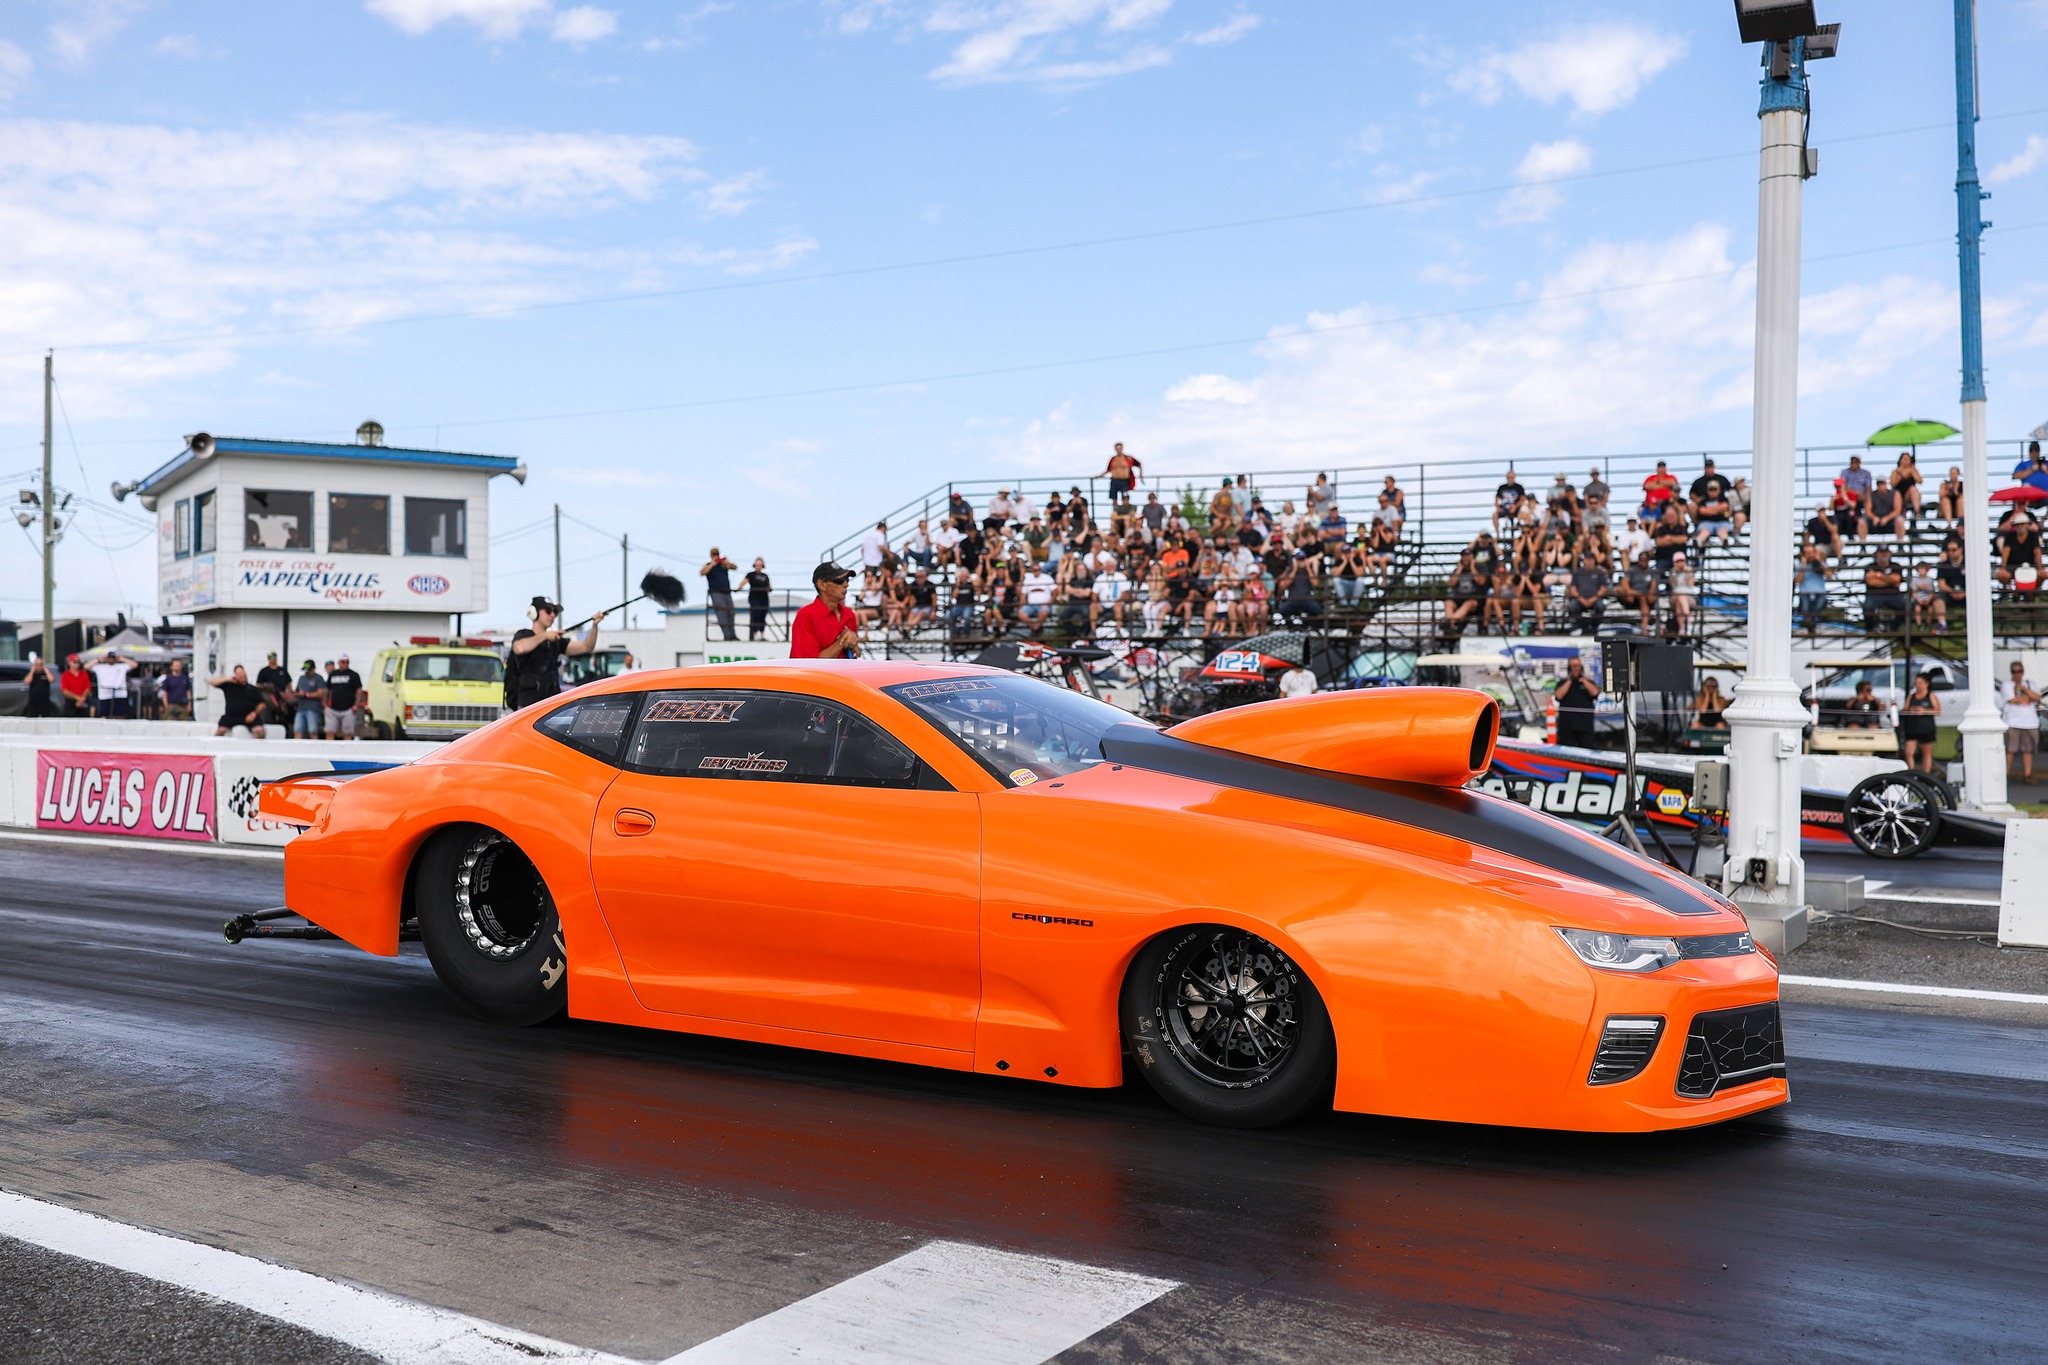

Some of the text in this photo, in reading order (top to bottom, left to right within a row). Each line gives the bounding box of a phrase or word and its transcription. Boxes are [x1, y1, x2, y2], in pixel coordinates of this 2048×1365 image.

[269, 560, 282, 569] DE
[291, 560, 335, 573] COURSE
[239, 571, 379, 593] NAPIERVILLE
[411, 576, 447, 592] NHRA
[324, 589, 383, 602] DRAGWAY
[1216, 652, 1259, 671] 124
[643, 700, 746, 722] 1826X
[699, 755, 787, 772] KEV POITRAS
[1016, 774, 1035, 783] KING
[39, 766, 206, 832] LUCAS OIL
[1662, 796, 1682, 806] NAPA
[480, 851, 497, 893] WELD
[1012, 912, 1093, 927] CAMARO
[1155, 932, 1197, 1056] WELD RACING
